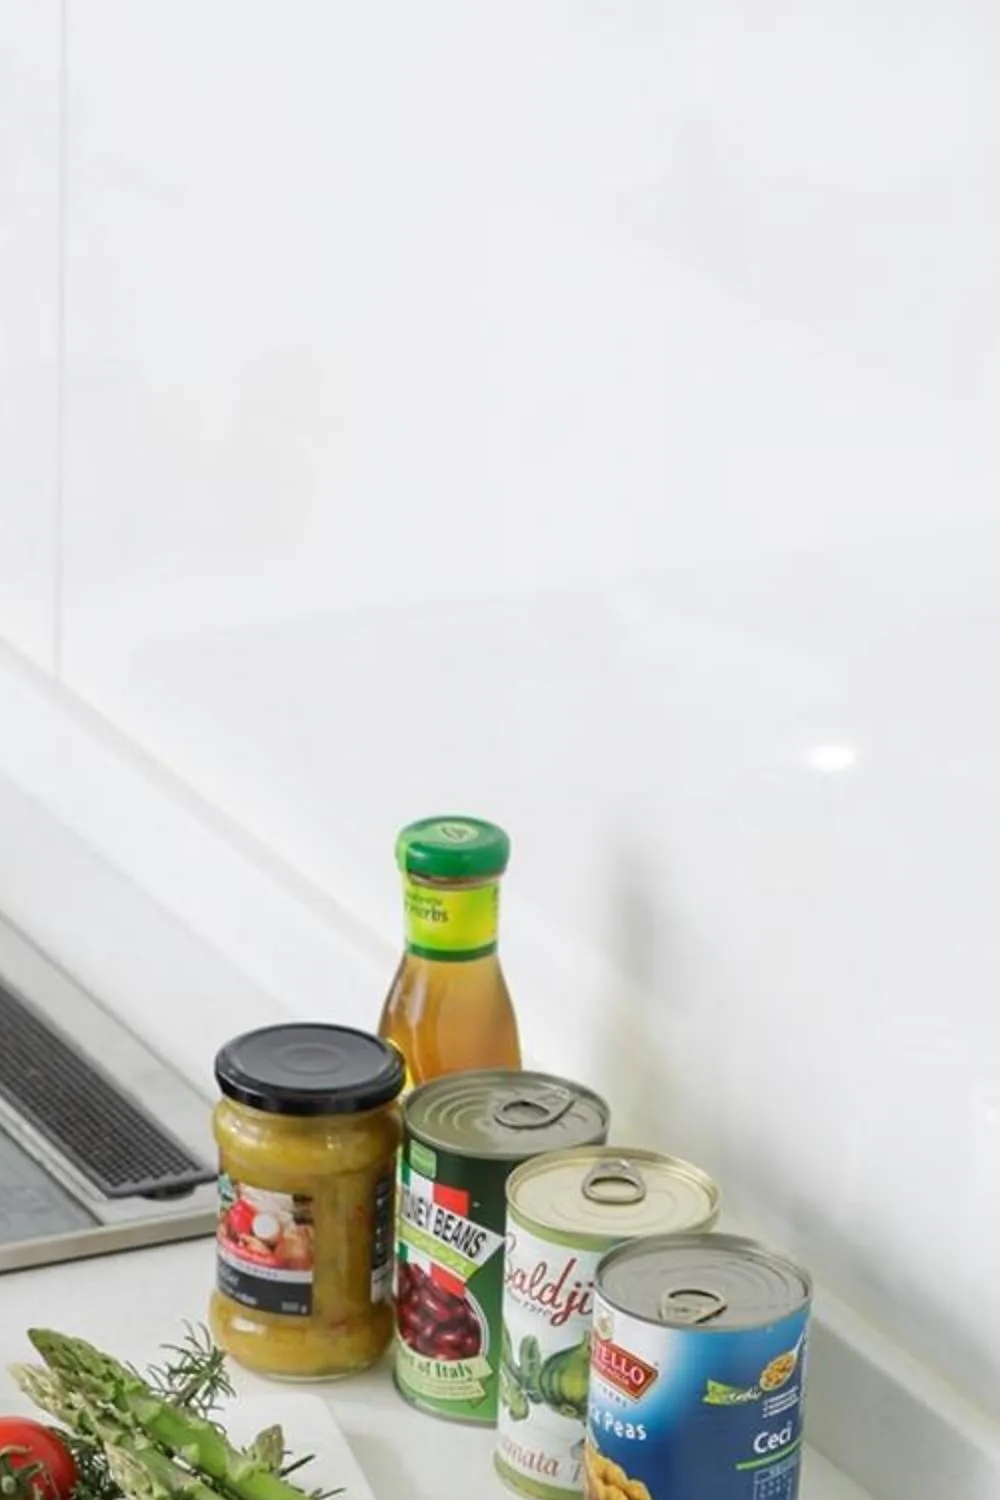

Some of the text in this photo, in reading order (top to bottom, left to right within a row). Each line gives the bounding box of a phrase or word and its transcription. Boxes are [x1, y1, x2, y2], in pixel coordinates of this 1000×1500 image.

[433, 1208, 487, 1258] BEANS
[436, 1362, 474, 1381] Italy
[604, 1411, 648, 1441] Peas
